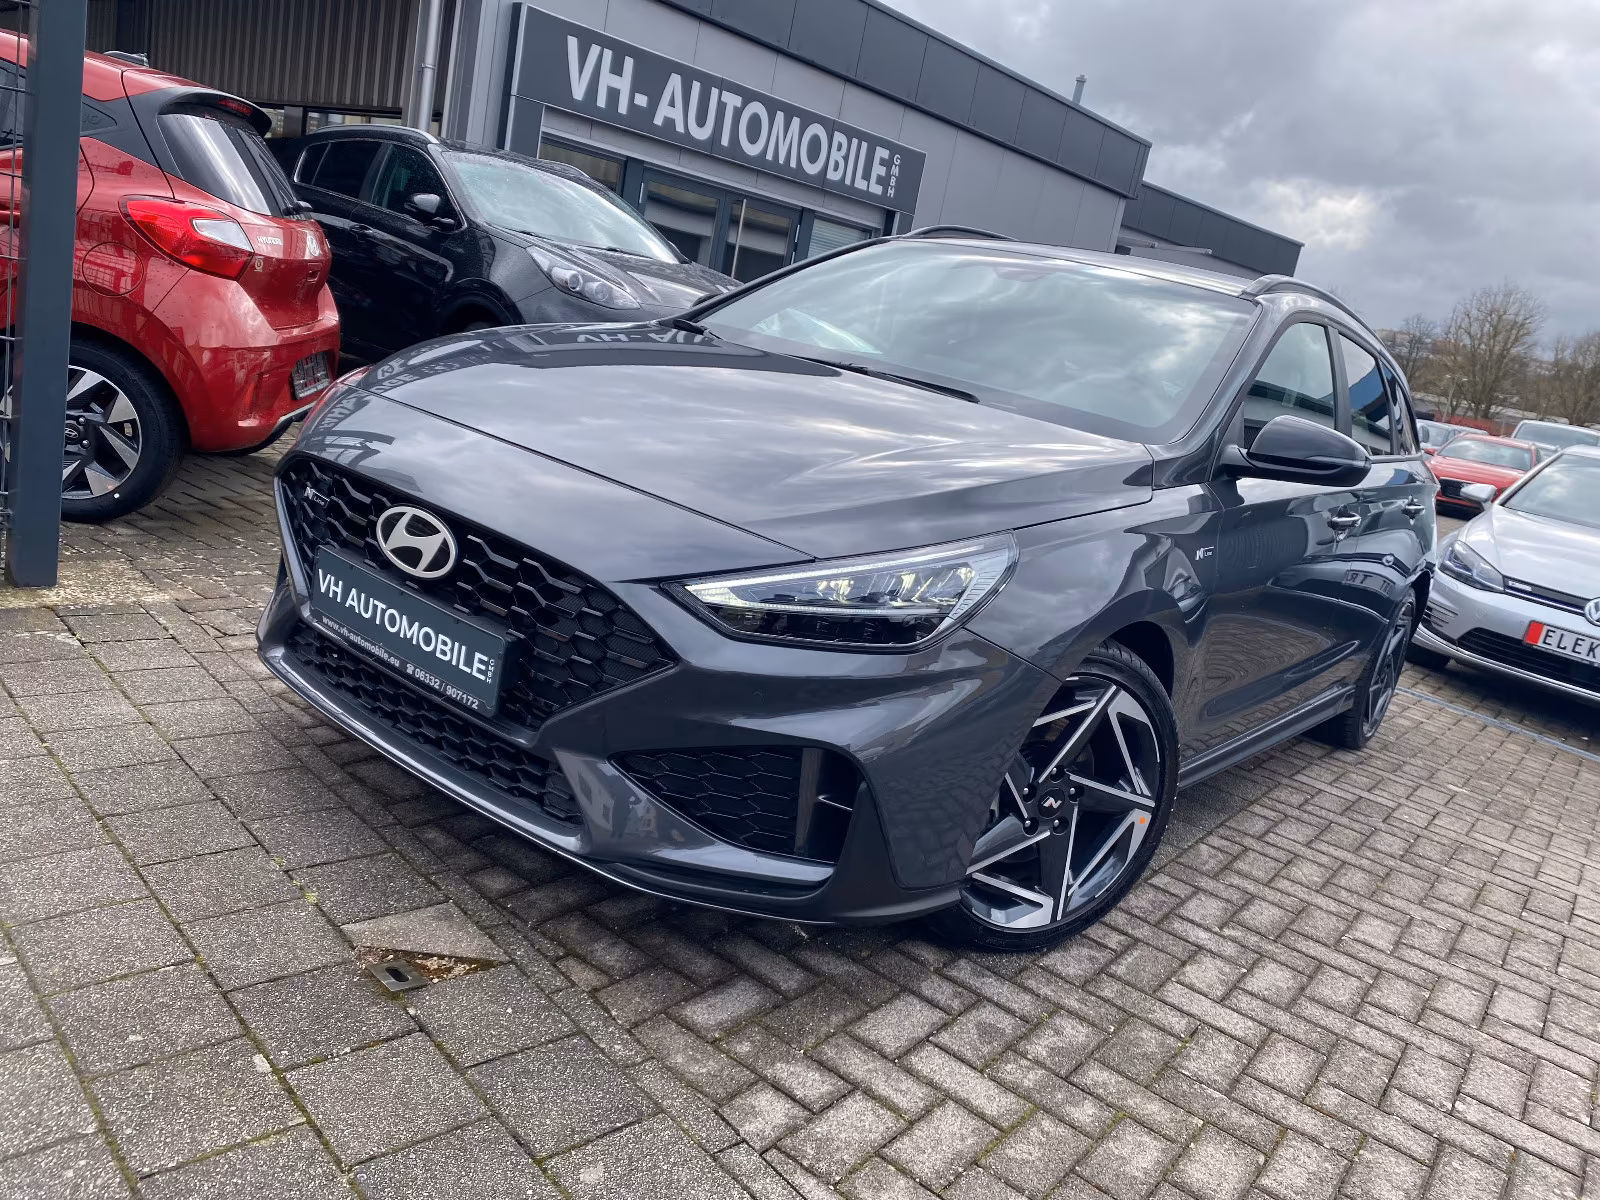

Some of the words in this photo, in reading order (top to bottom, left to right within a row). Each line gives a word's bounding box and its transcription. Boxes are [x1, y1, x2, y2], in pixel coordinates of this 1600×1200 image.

[887, 154, 901, 198] GMBH
[318, 568, 343, 603] VH
[345, 588, 488, 681] AUTOMOBILE
[1543, 629, 1600, 658] ELEK
[322, 615, 400, 668] www.vh-automobile.eu
[415, 668, 440, 689] 06332
[446, 686, 479, 709] 907172
